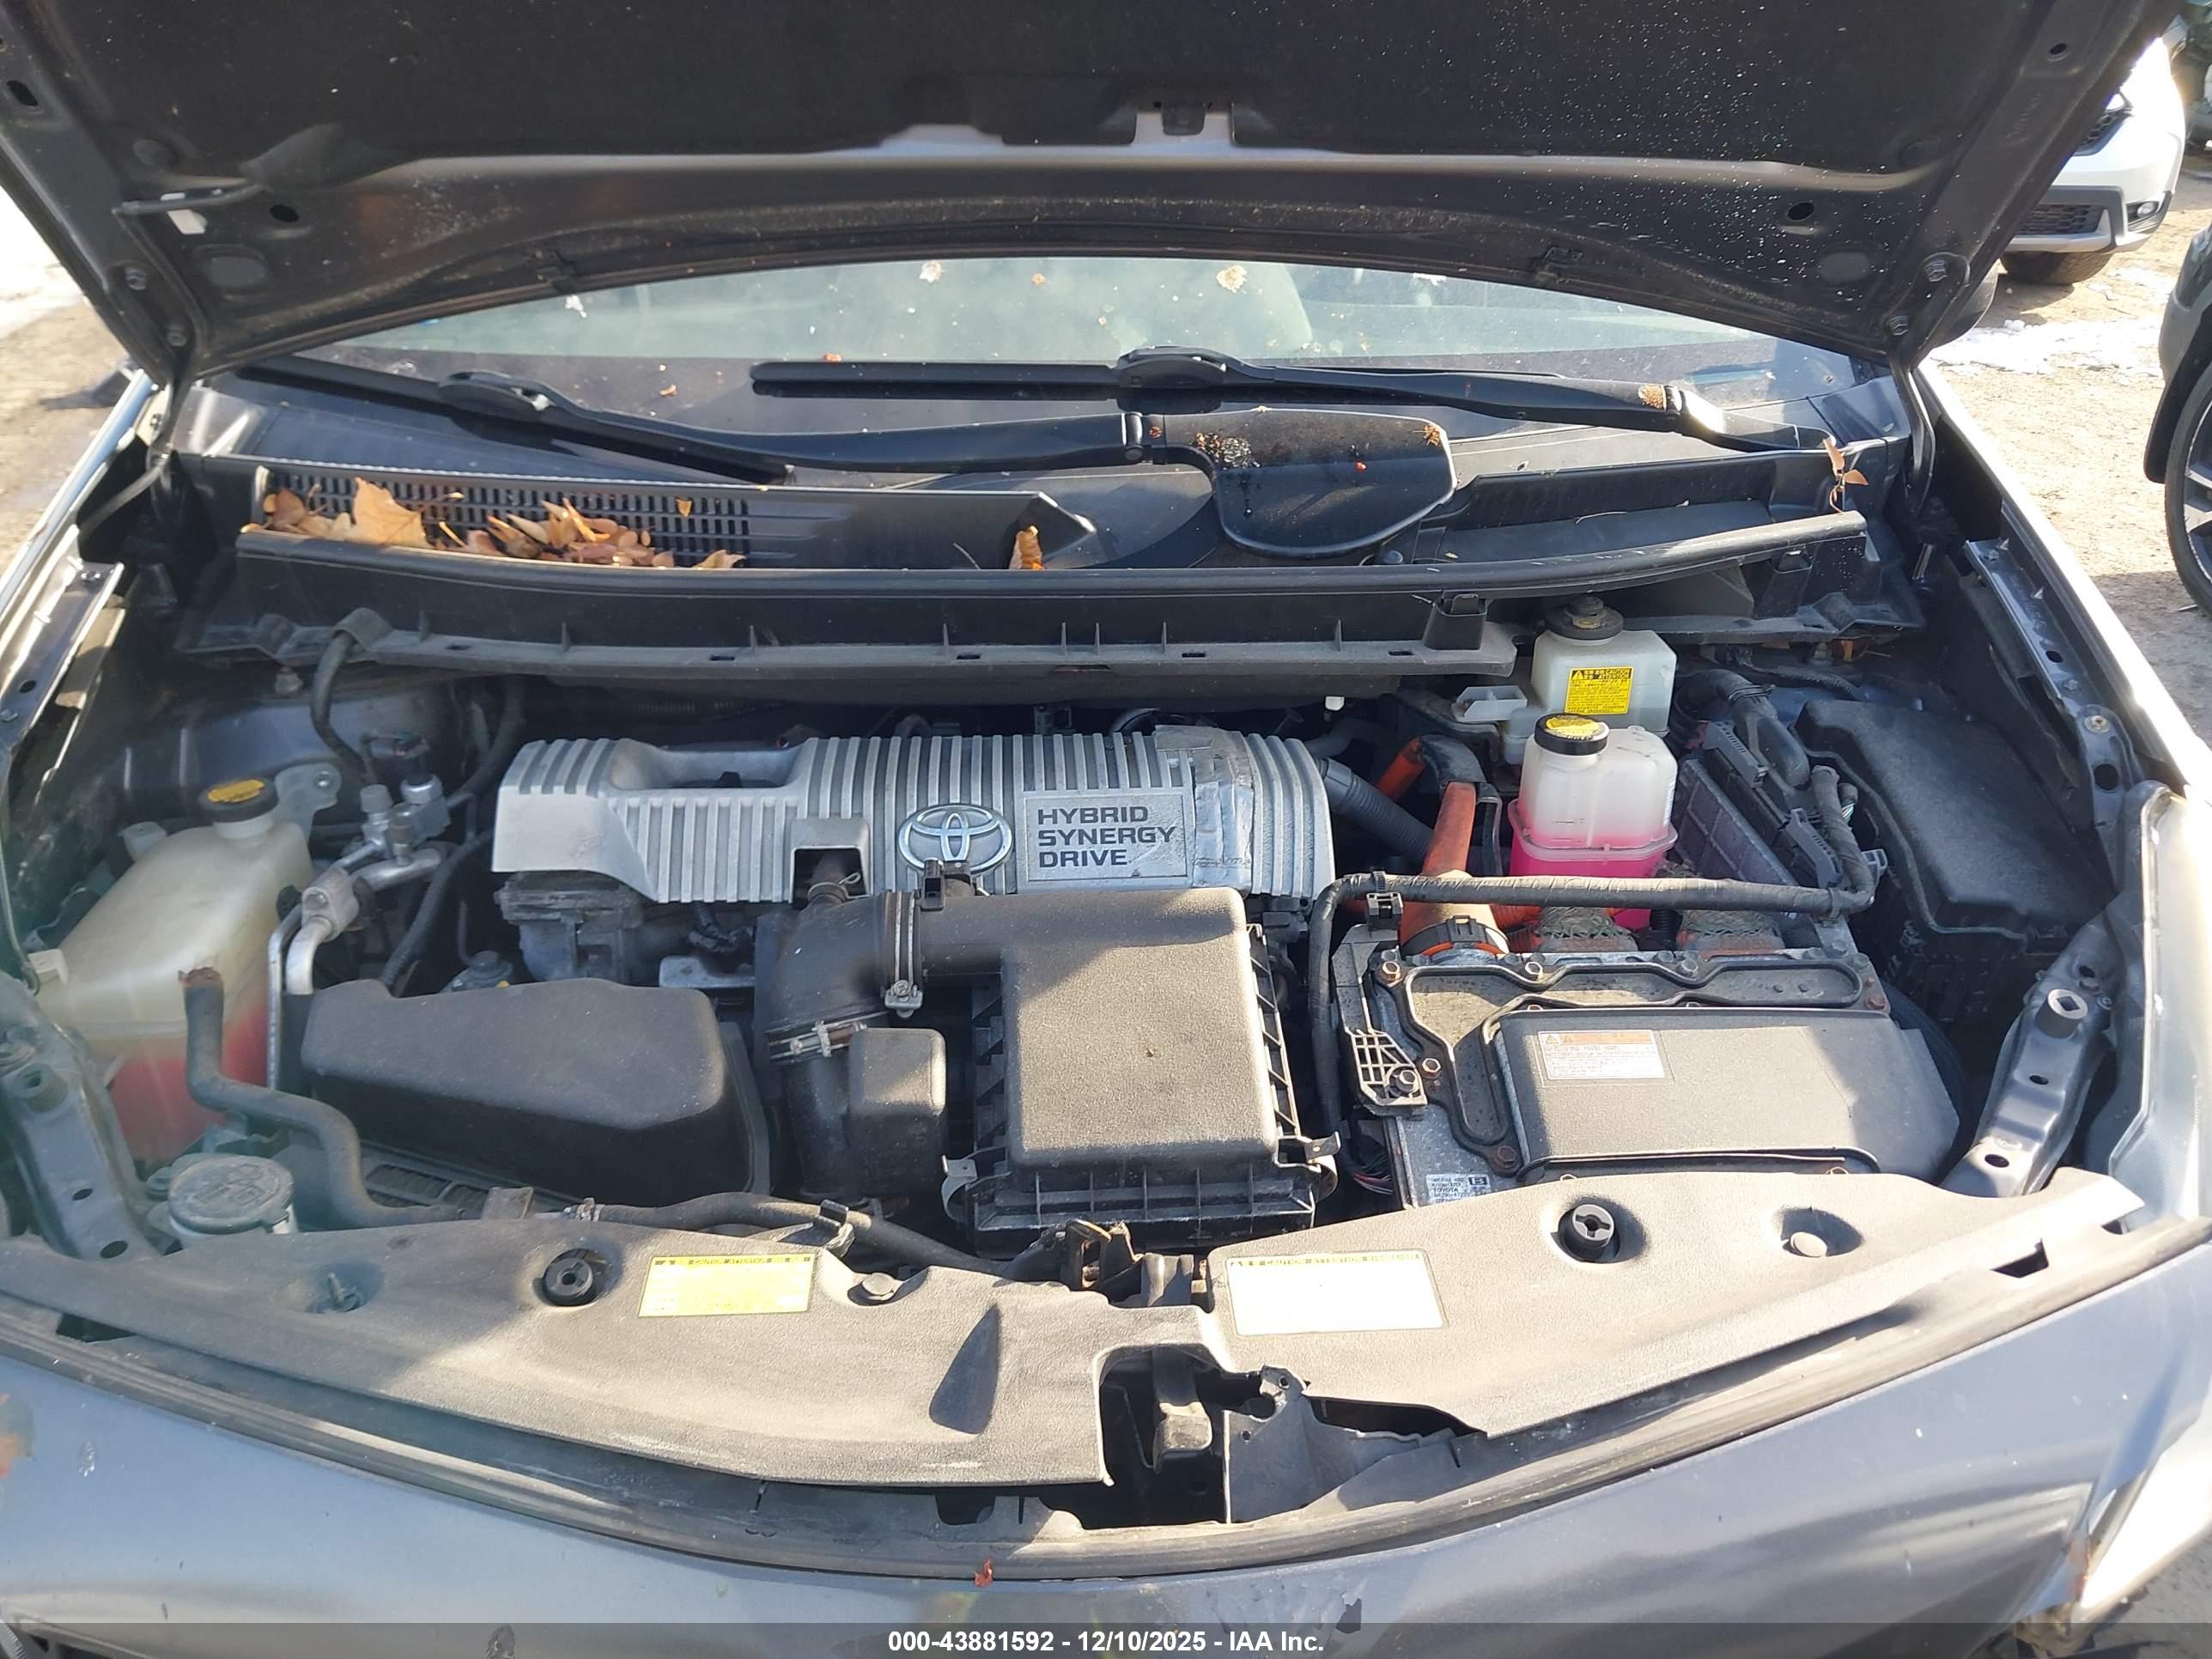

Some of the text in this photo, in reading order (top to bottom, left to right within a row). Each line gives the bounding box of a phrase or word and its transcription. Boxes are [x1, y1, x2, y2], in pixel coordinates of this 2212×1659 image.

[1038, 806, 1148, 825] HYBRID
[1038, 826, 1176, 846] SYNERGY
[1039, 849, 1128, 868] DRIVE
